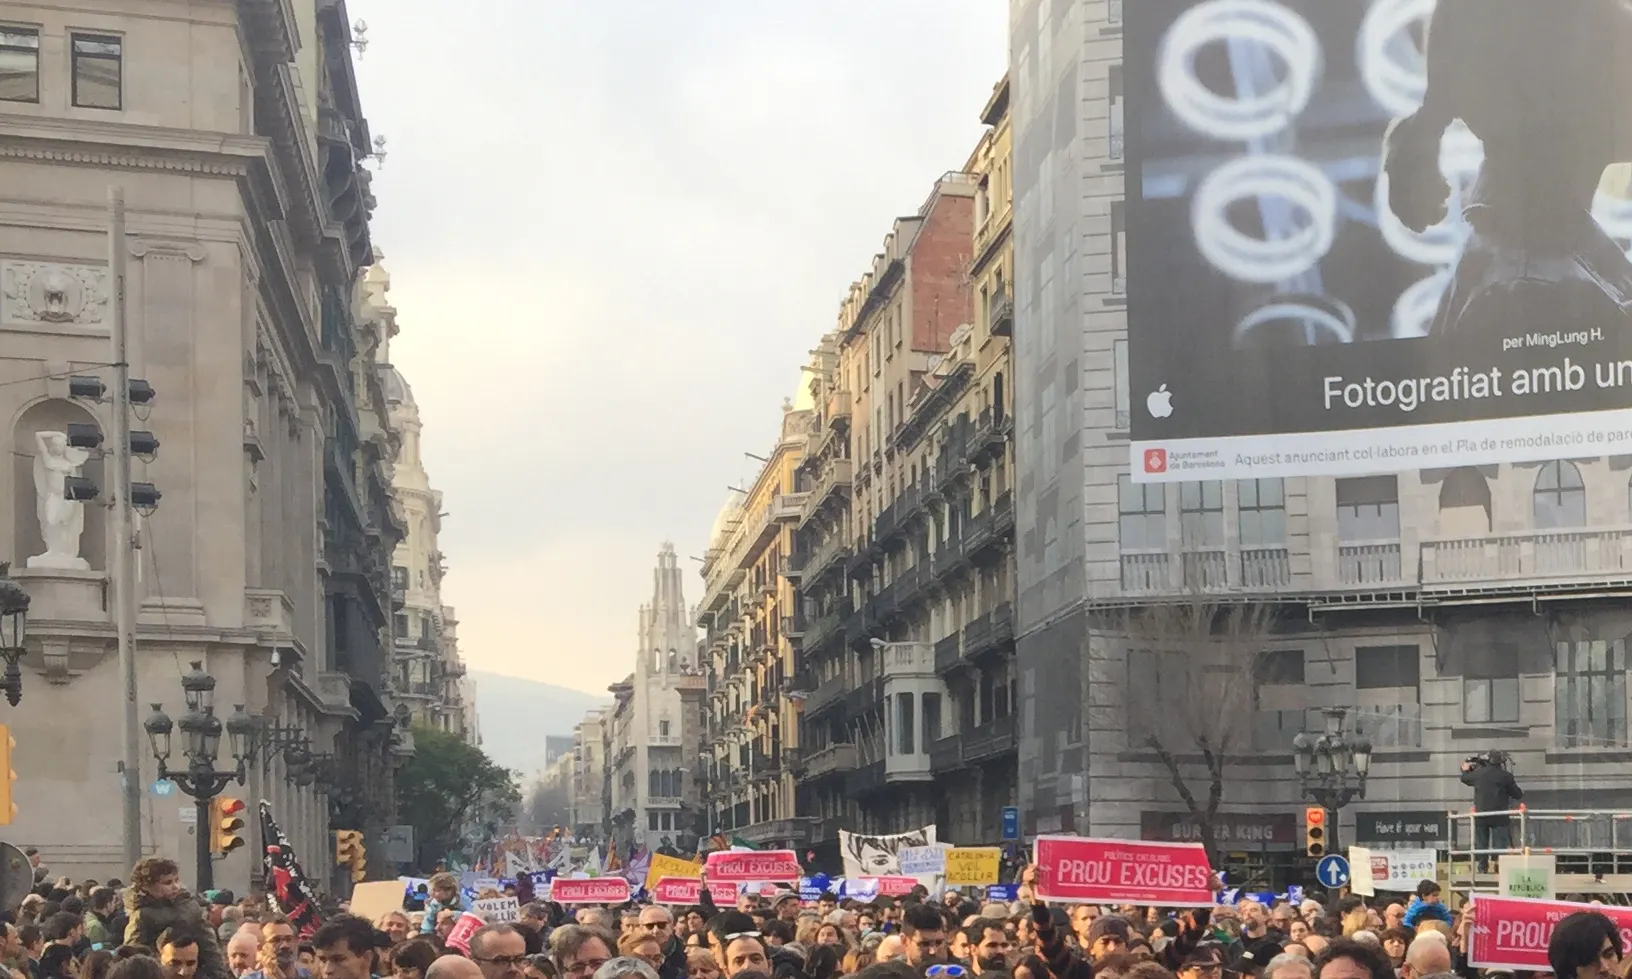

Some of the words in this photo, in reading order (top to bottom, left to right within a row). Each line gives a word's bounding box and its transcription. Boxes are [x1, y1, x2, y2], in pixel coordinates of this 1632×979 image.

[1502, 336, 1523, 351] per
[1525, 330, 1588, 349] MingLung
[1323, 367, 1502, 411] Fotografiat
[1512, 357, 1585, 395] amb
[1235, 452, 1280, 467] Aquest
[1285, 449, 1350, 464] anunciant
[1422, 443, 1438, 454] en
[1441, 439, 1452, 453] el
[1457, 438, 1477, 452] Pla
[1480, 436, 1496, 450] de
[1587, 429, 1603, 444] de
[1235, 824, 1273, 839] KING
[1376, 820, 1395, 834] Have
[717, 861, 745, 874] PROU
[749, 860, 798, 874] EXCUSES
[1058, 859, 1111, 884] PROU
[1120, 862, 1208, 889] EXCUSES
[477, 900, 517, 911] VOLEM
[1496, 919, 1550, 948] PROU
